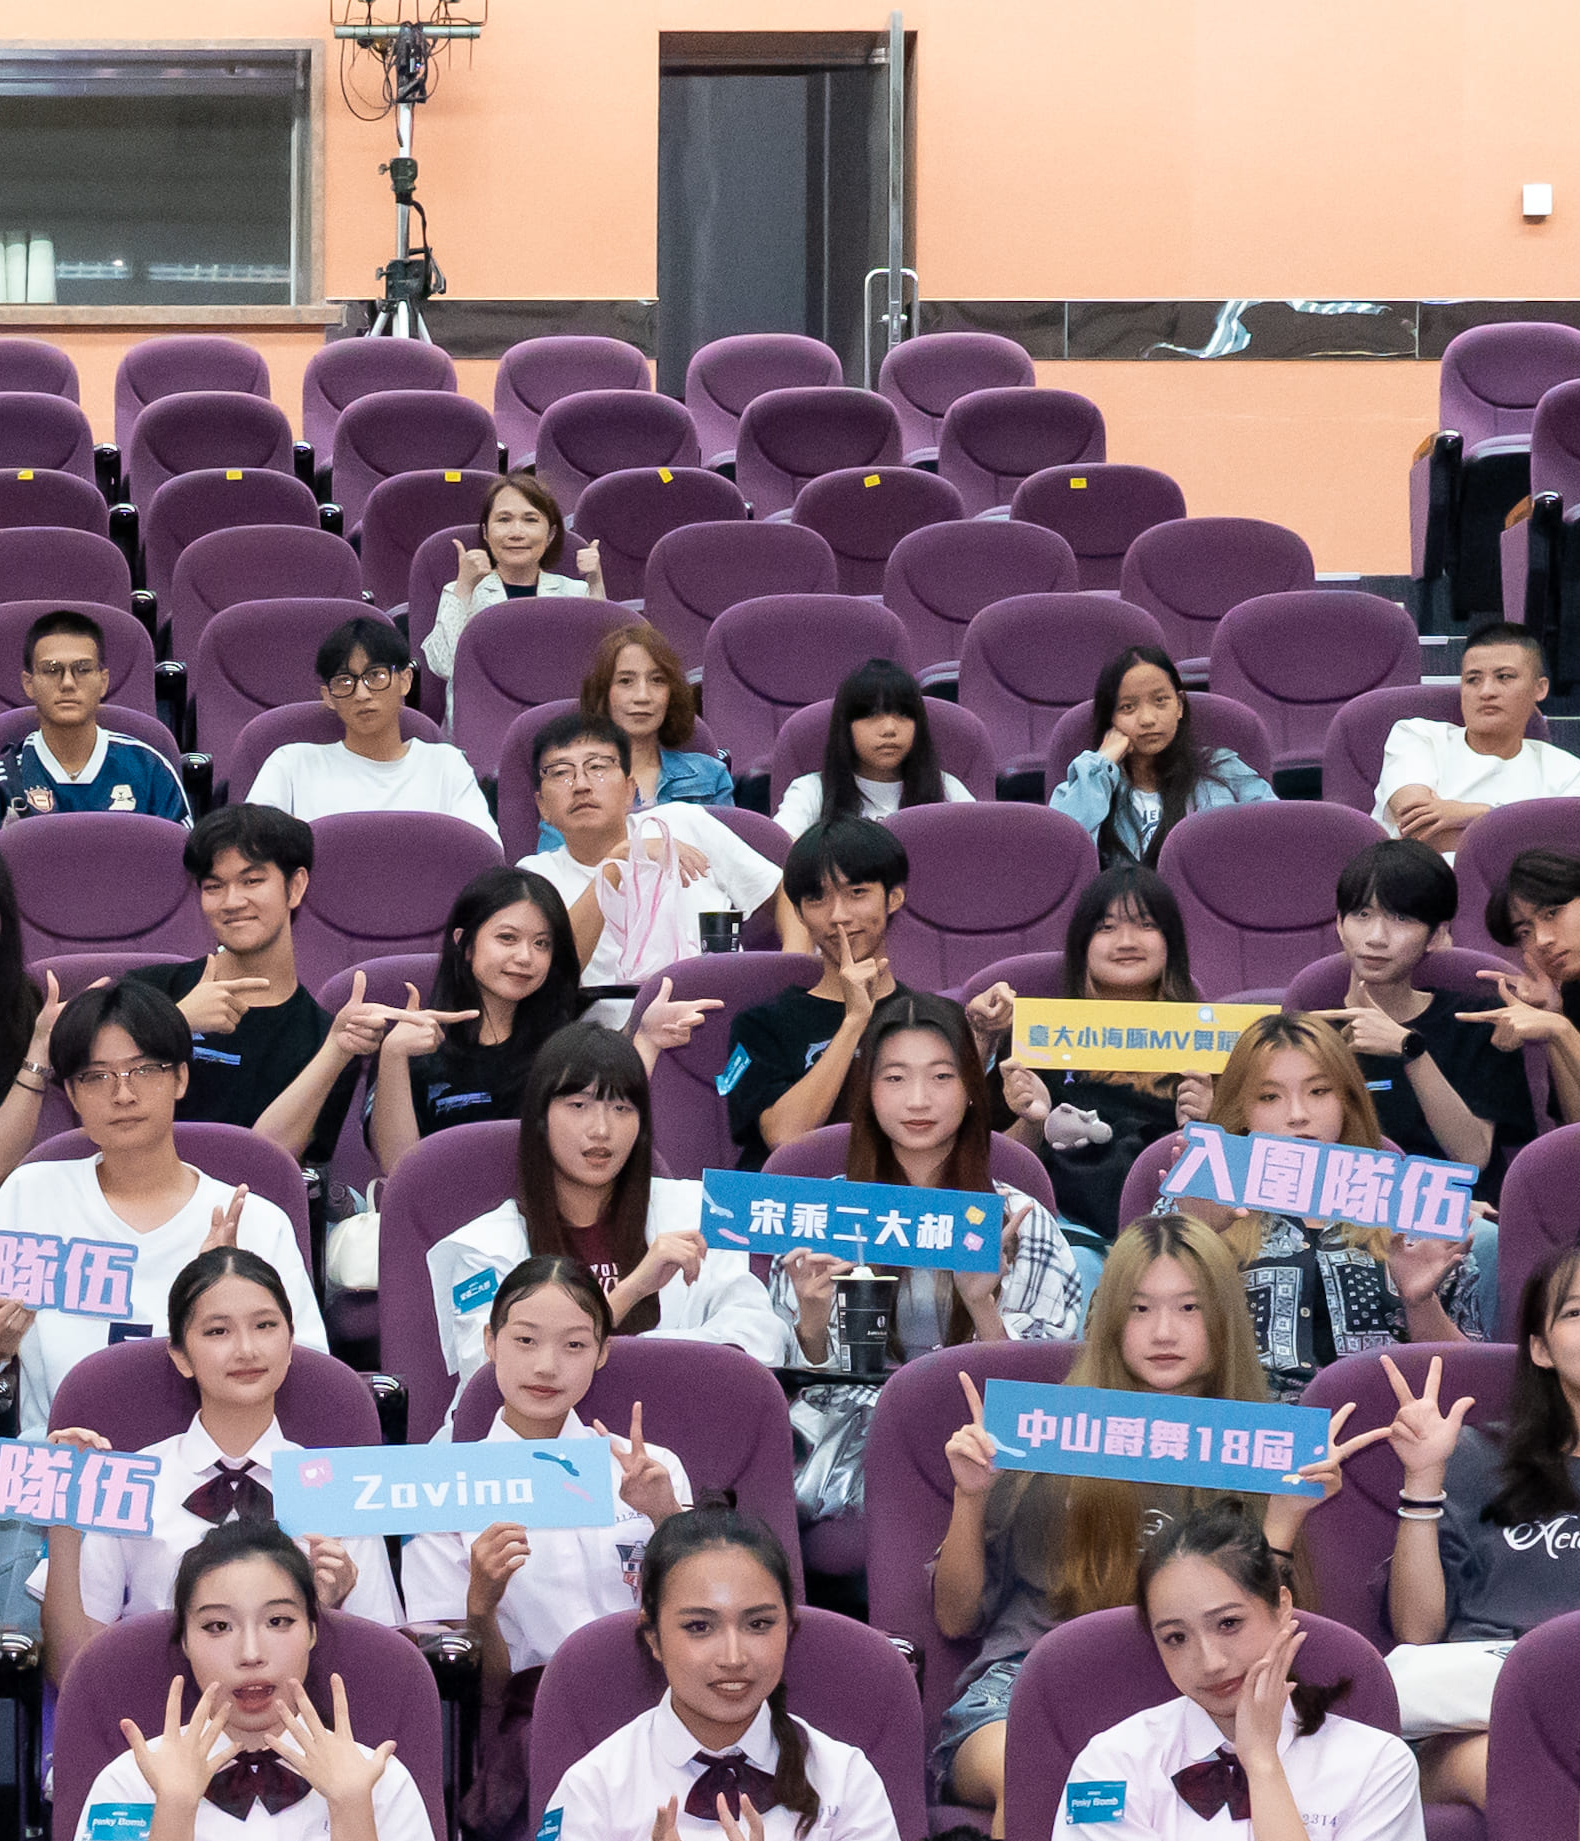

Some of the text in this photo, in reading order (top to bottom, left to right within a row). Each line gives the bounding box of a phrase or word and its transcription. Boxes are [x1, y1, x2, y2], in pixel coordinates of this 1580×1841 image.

[1166, 1126, 1473, 1238] 入圍隊伍
[1017, 1408, 1295, 1471] 中山爵舞18屆
[353, 1474, 534, 1512] Zavina
